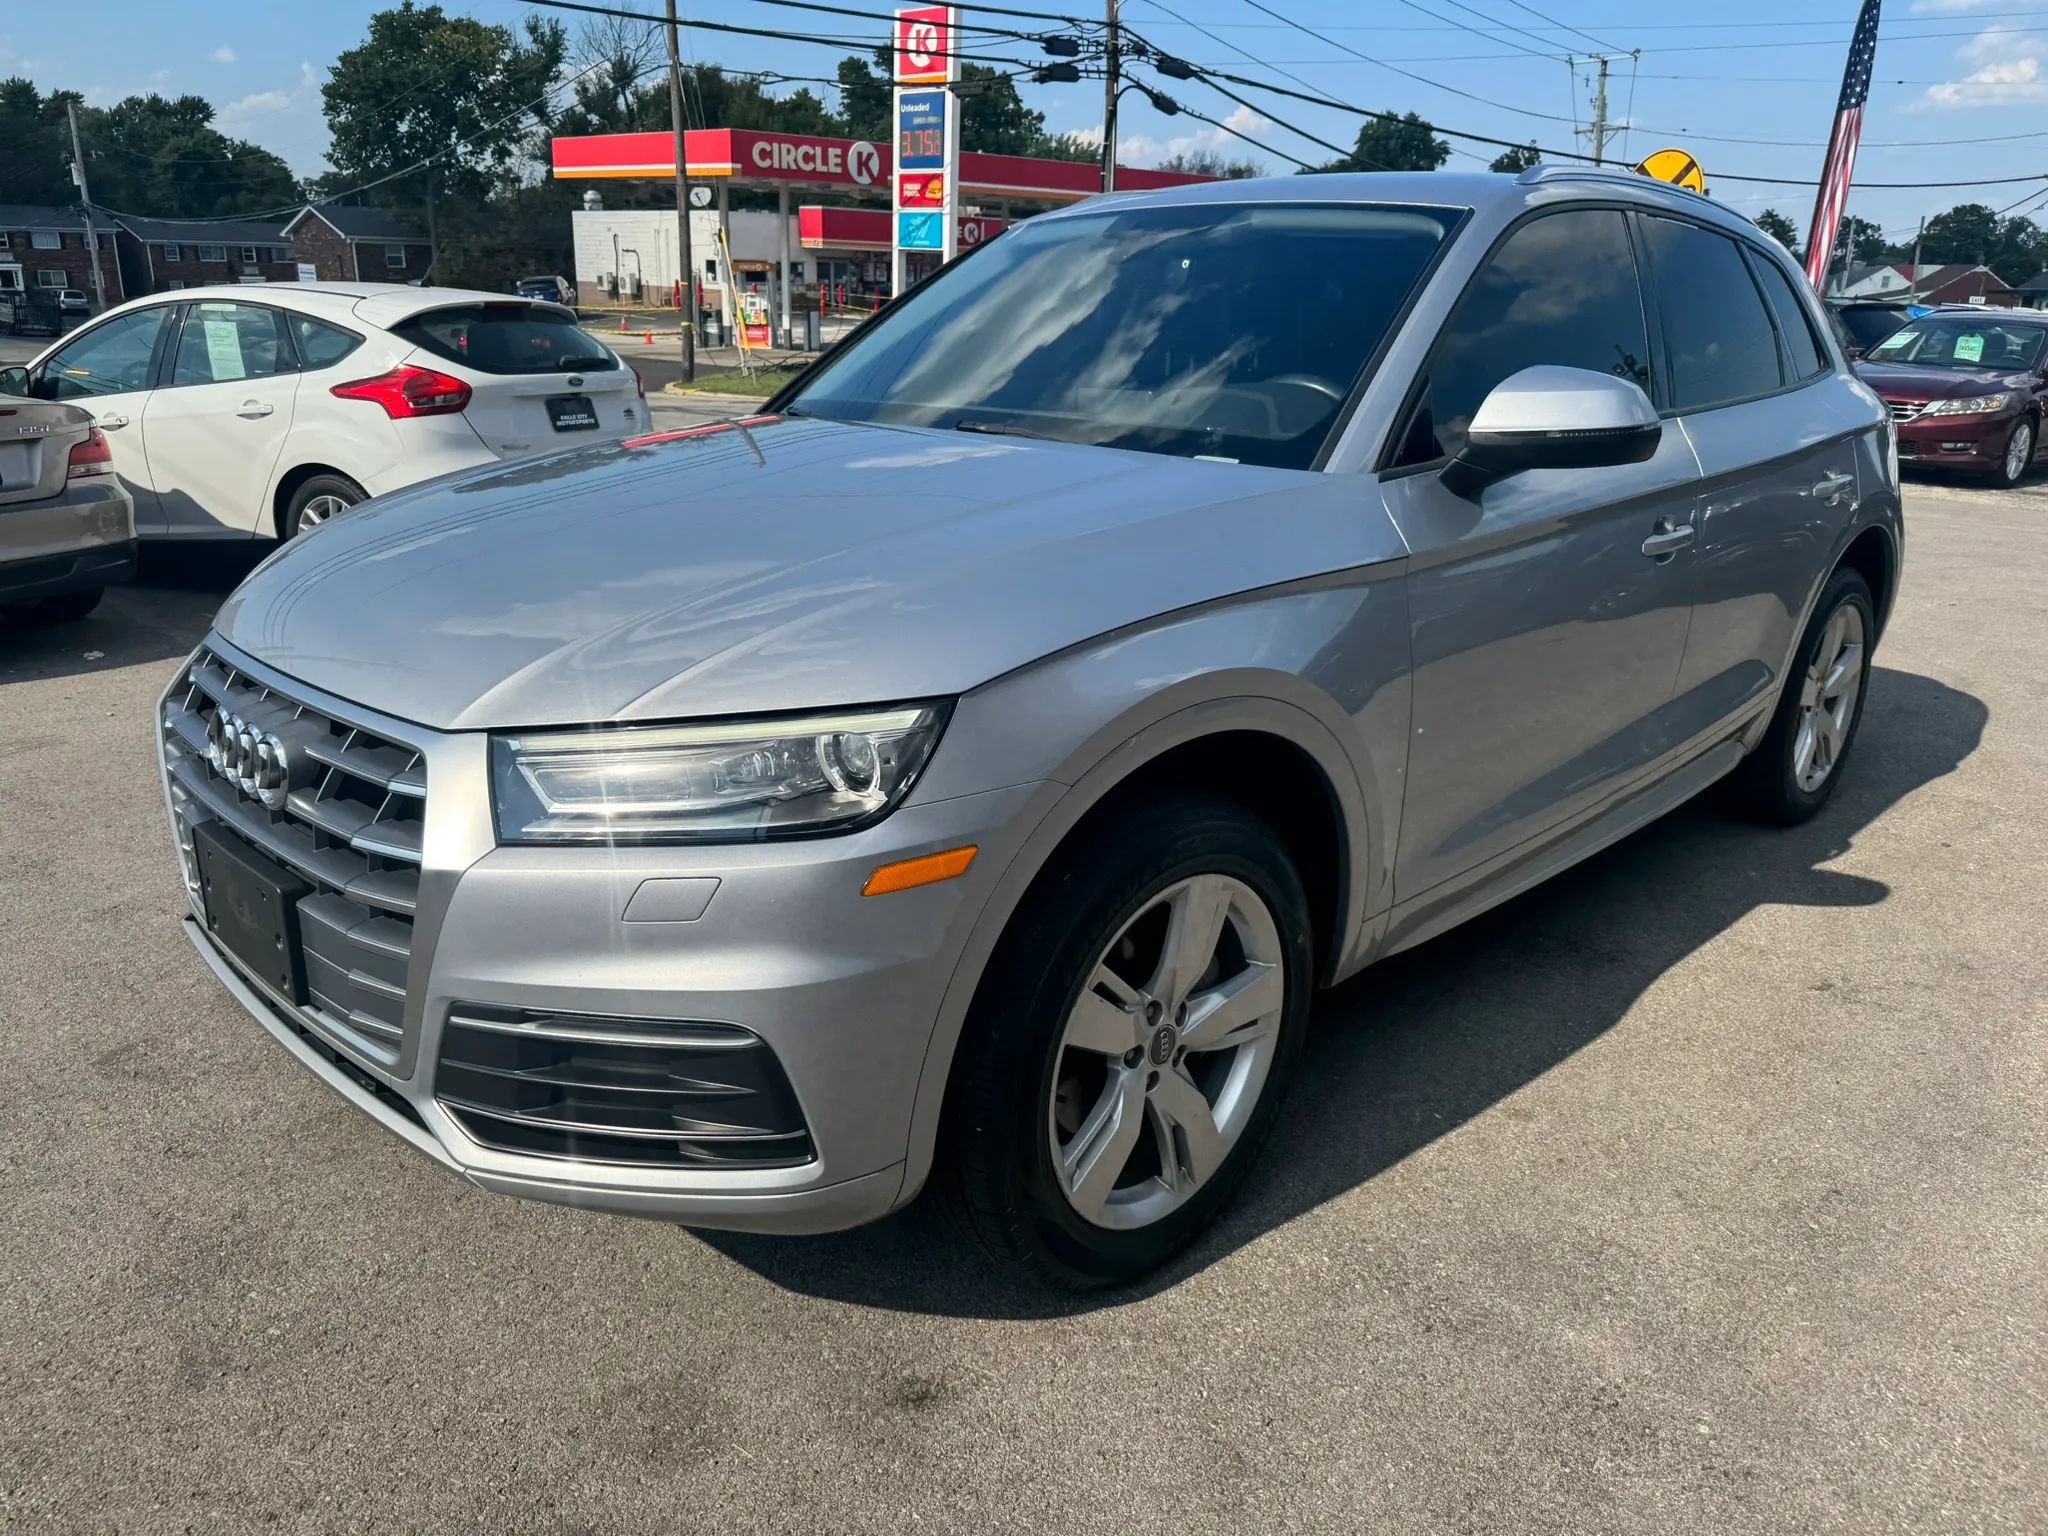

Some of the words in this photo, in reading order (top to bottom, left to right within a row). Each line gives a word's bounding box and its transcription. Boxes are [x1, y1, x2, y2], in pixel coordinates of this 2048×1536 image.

[900, 102, 930, 113] Unleaded
[752, 141, 842, 173] CIRCLE
[556, 418, 595, 426] MOTORSPORTS
